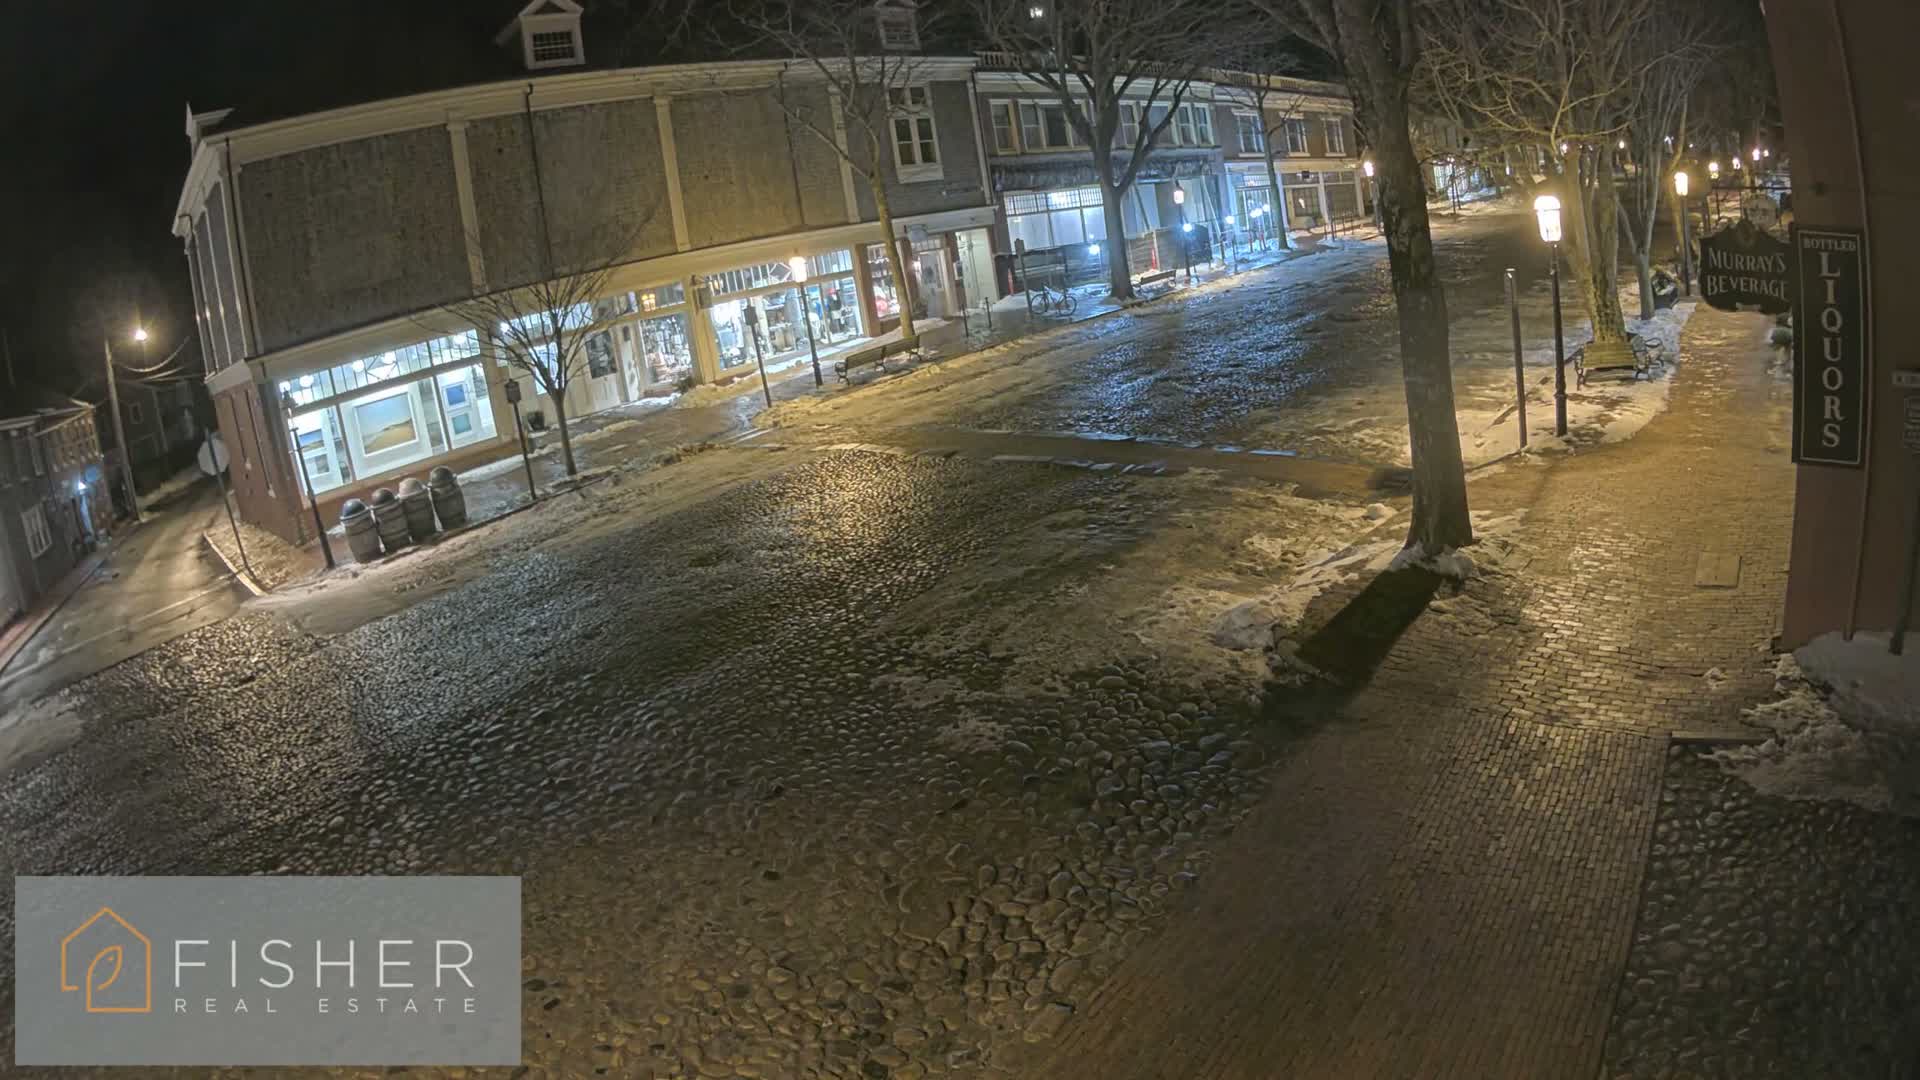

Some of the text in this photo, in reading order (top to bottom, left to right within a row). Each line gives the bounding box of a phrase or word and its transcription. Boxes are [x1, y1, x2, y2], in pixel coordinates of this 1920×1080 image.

[1803, 238, 1857, 251] BOTTLED
[1708, 277, 1788, 301] BEVERAGE
[1818, 251, 1843, 448] LIQUORS
